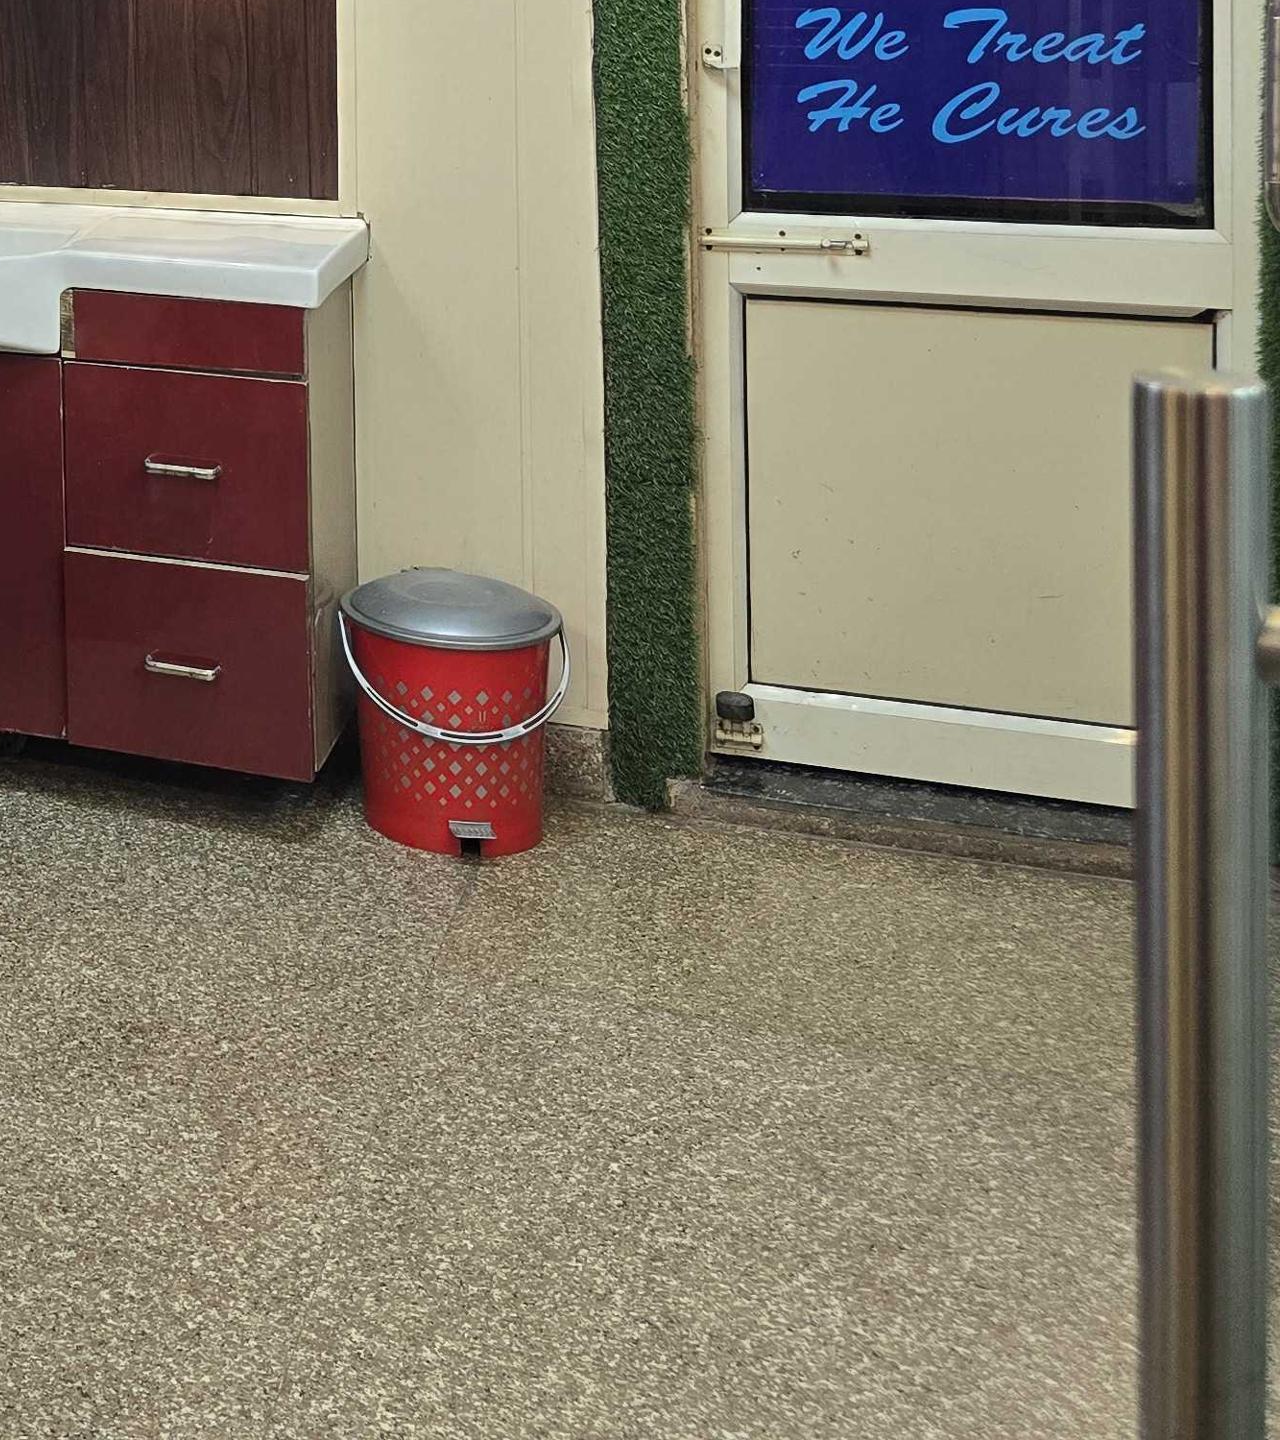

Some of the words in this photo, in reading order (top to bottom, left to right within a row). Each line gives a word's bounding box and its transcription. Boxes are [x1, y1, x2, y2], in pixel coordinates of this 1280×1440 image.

[795, 7, 910, 61] We
[943, 7, 1146, 65] Treat
[797, 78, 905, 135] He
[931, 81, 1147, 144] Cures
